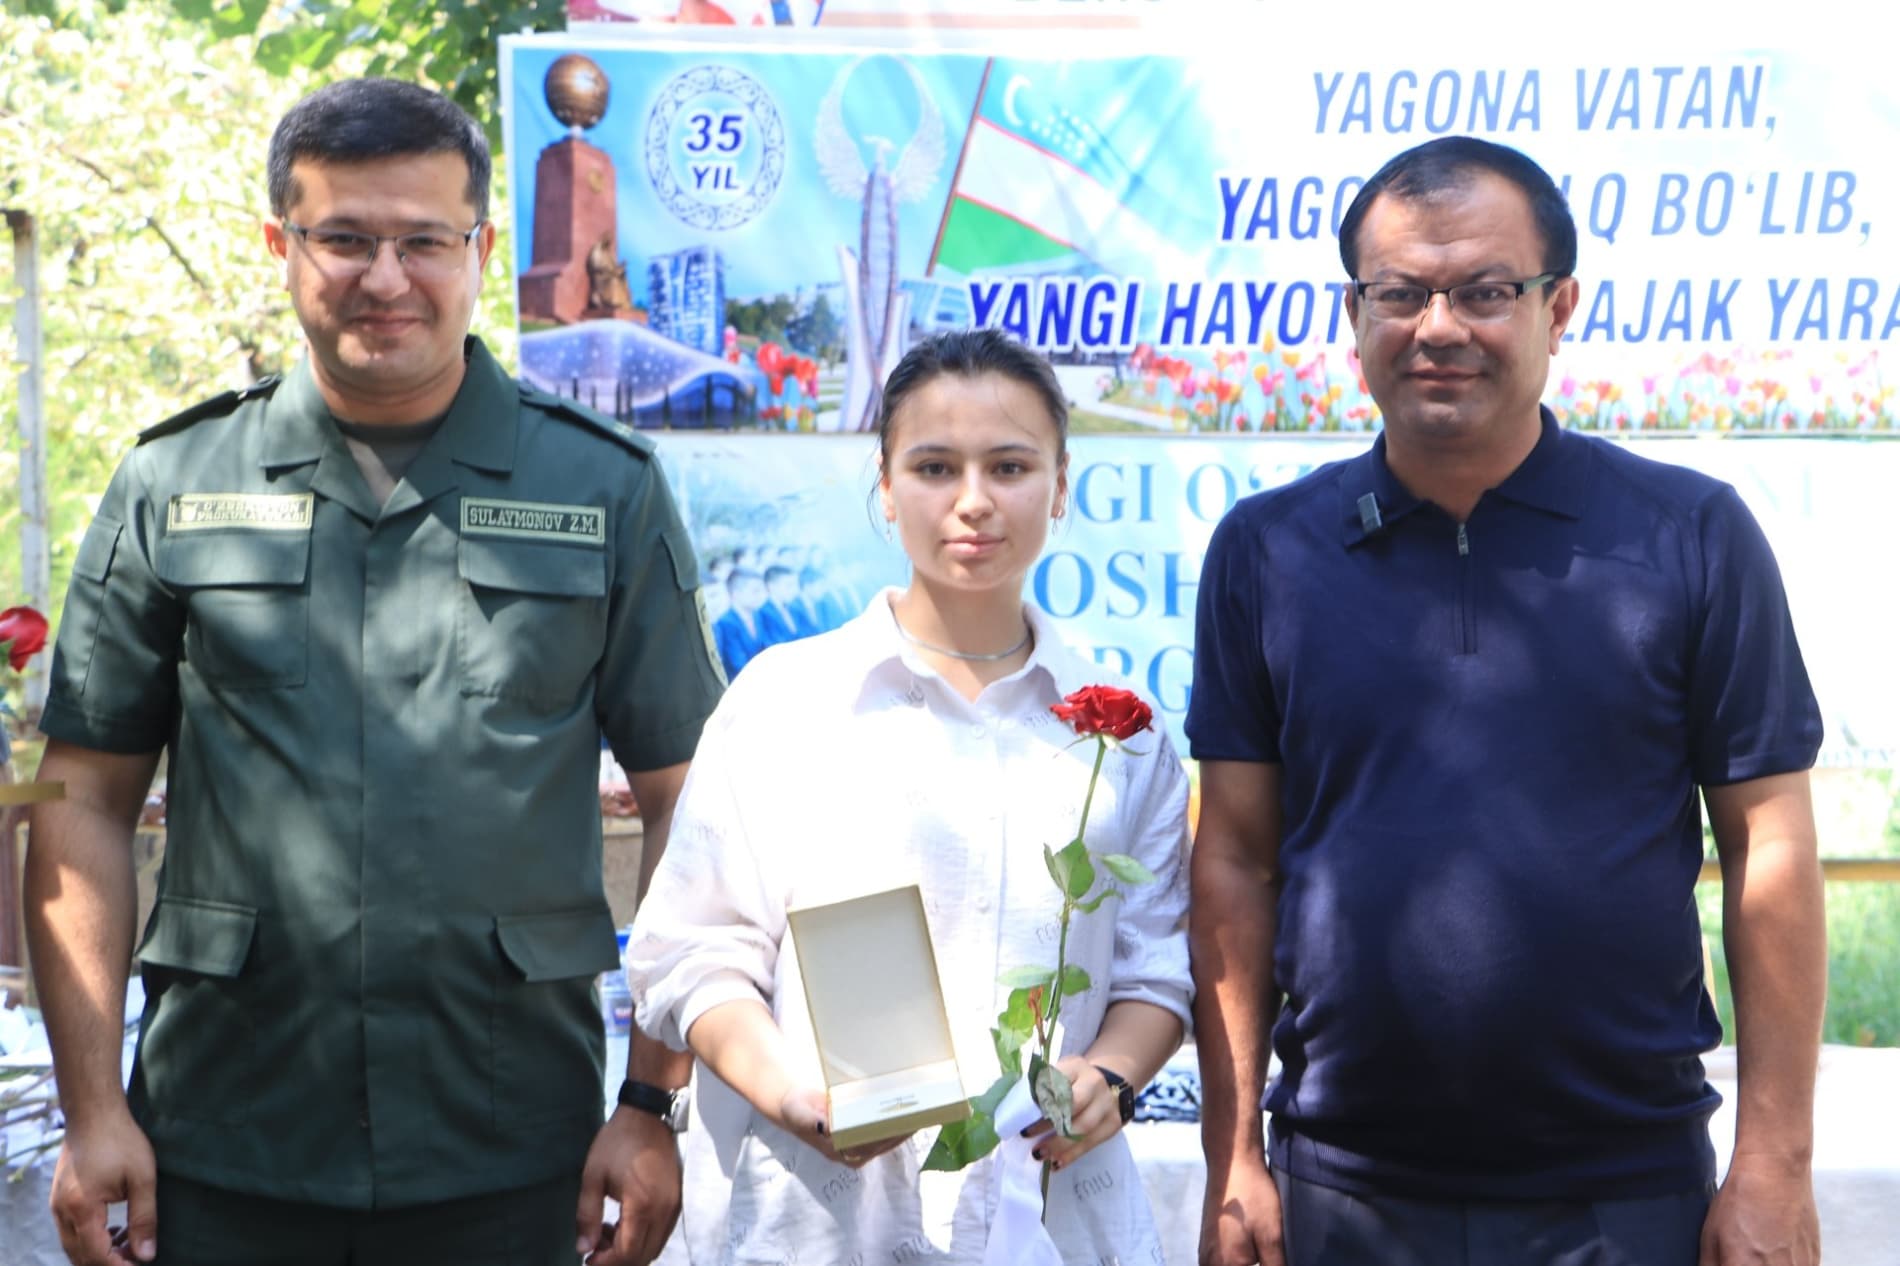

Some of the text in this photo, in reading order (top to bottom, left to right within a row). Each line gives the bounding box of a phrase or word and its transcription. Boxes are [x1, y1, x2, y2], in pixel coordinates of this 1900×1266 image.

[686, 114, 743, 152] 35
[1312, 65, 1778, 140] YAGONA VATAN,
[692, 166, 740, 190] YIL
[1219, 175, 1366, 241] YAGO
[969, 281, 1140, 346] YANGI
[1160, 280, 1347, 345] HAYOT
[469, 506, 598, 536] SULAYMONOV Z.M.
[1074, 462, 1156, 524] GI
[1031, 551, 1200, 619] OSH
